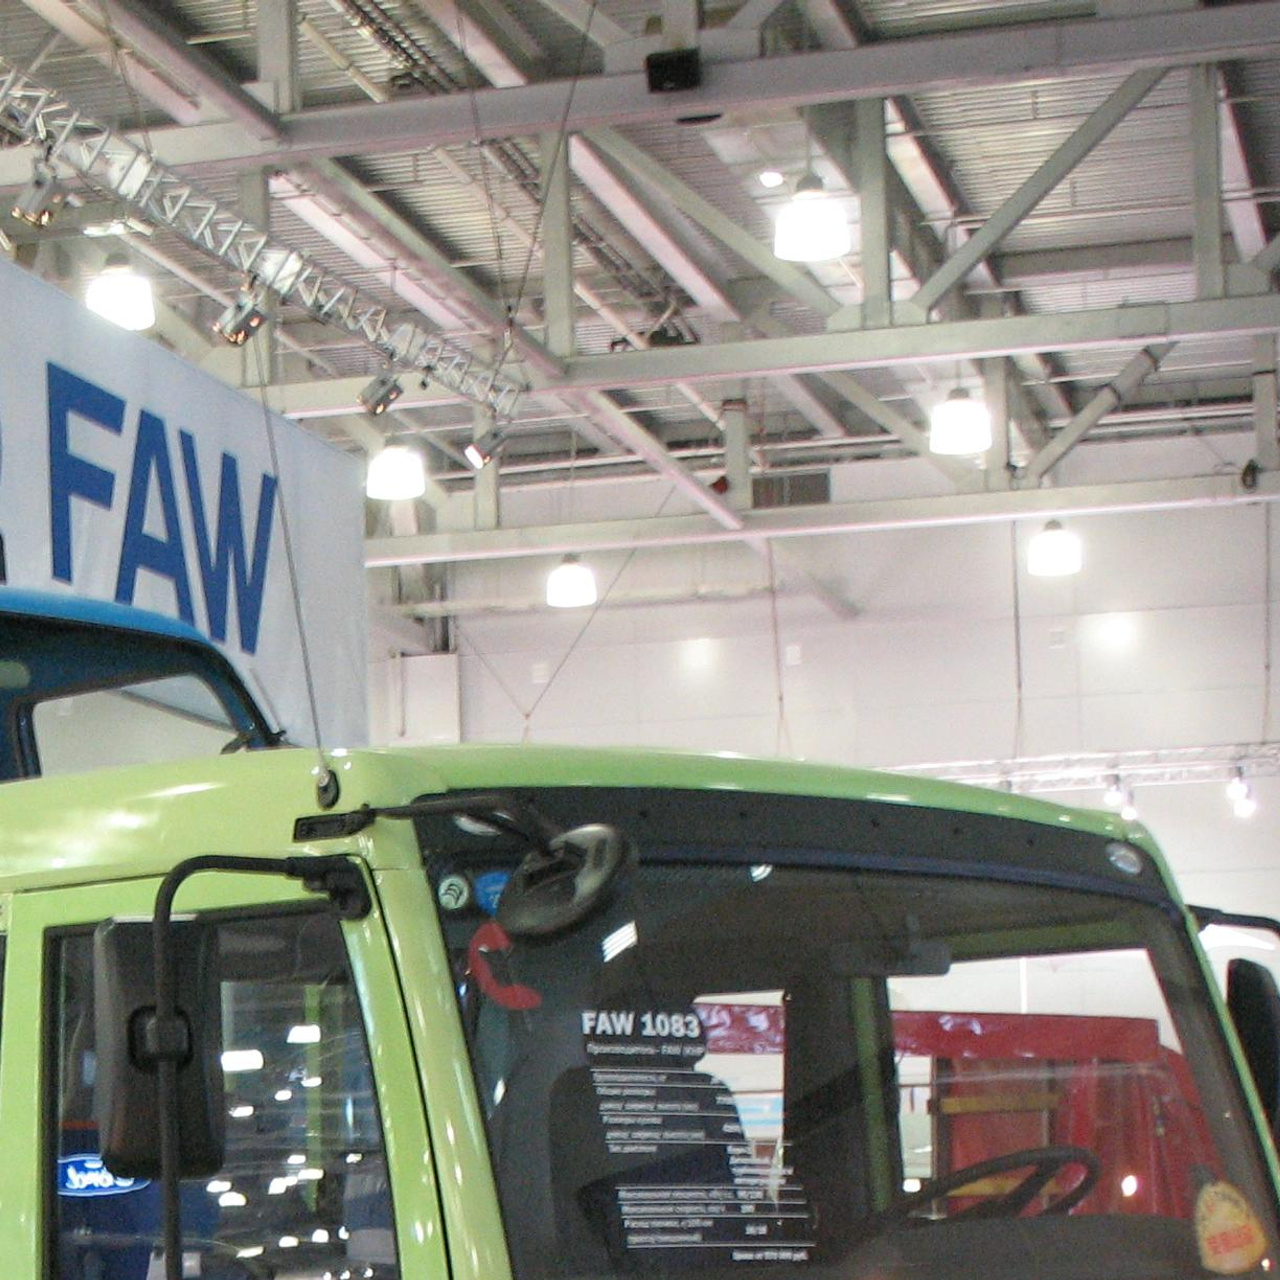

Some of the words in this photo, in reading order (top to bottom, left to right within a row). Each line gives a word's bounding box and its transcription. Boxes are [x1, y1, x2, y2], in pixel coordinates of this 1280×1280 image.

[47, 361, 278, 657] FAW
[581, 1010, 635, 1036] FAW
[640, 1010, 701, 1039] 1083
